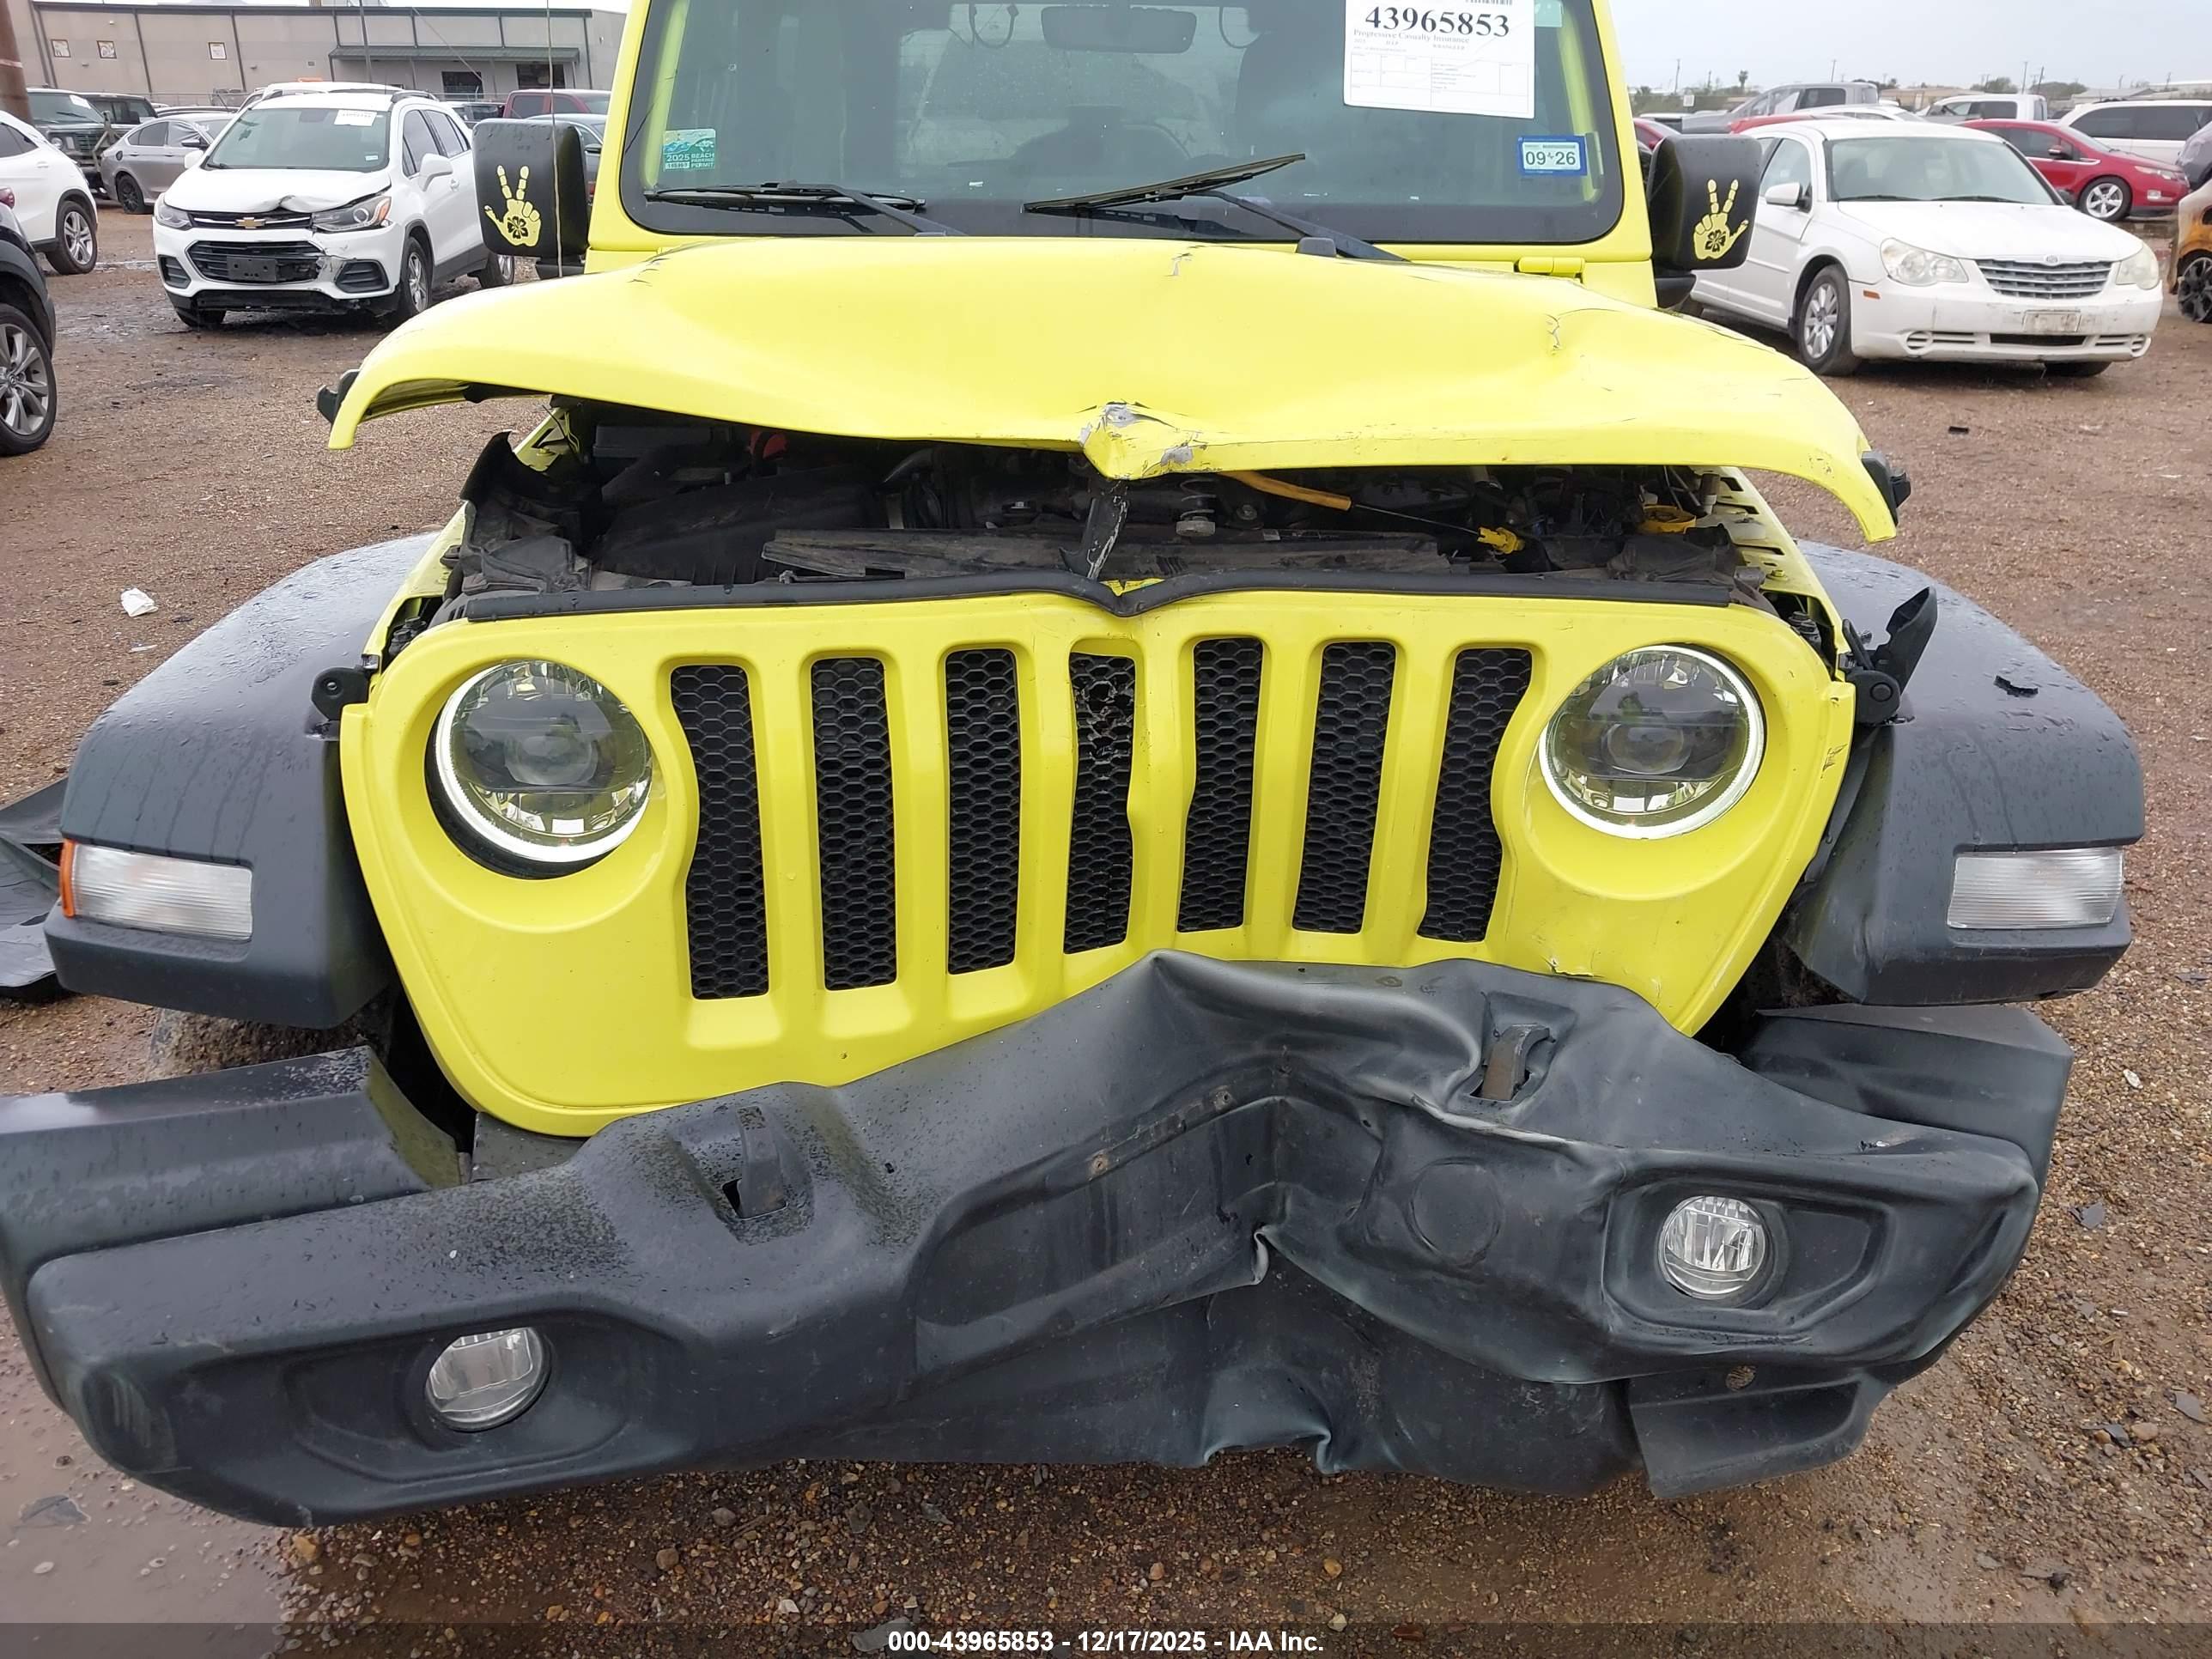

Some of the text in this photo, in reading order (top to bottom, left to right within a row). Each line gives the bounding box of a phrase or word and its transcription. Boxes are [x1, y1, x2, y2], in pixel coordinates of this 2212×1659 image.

[1364, 6, 1510, 37] 43965853
[1353, 28, 1470, 44] Progressive Casualty Insurance
[1525, 151, 1576, 165] 09 26
